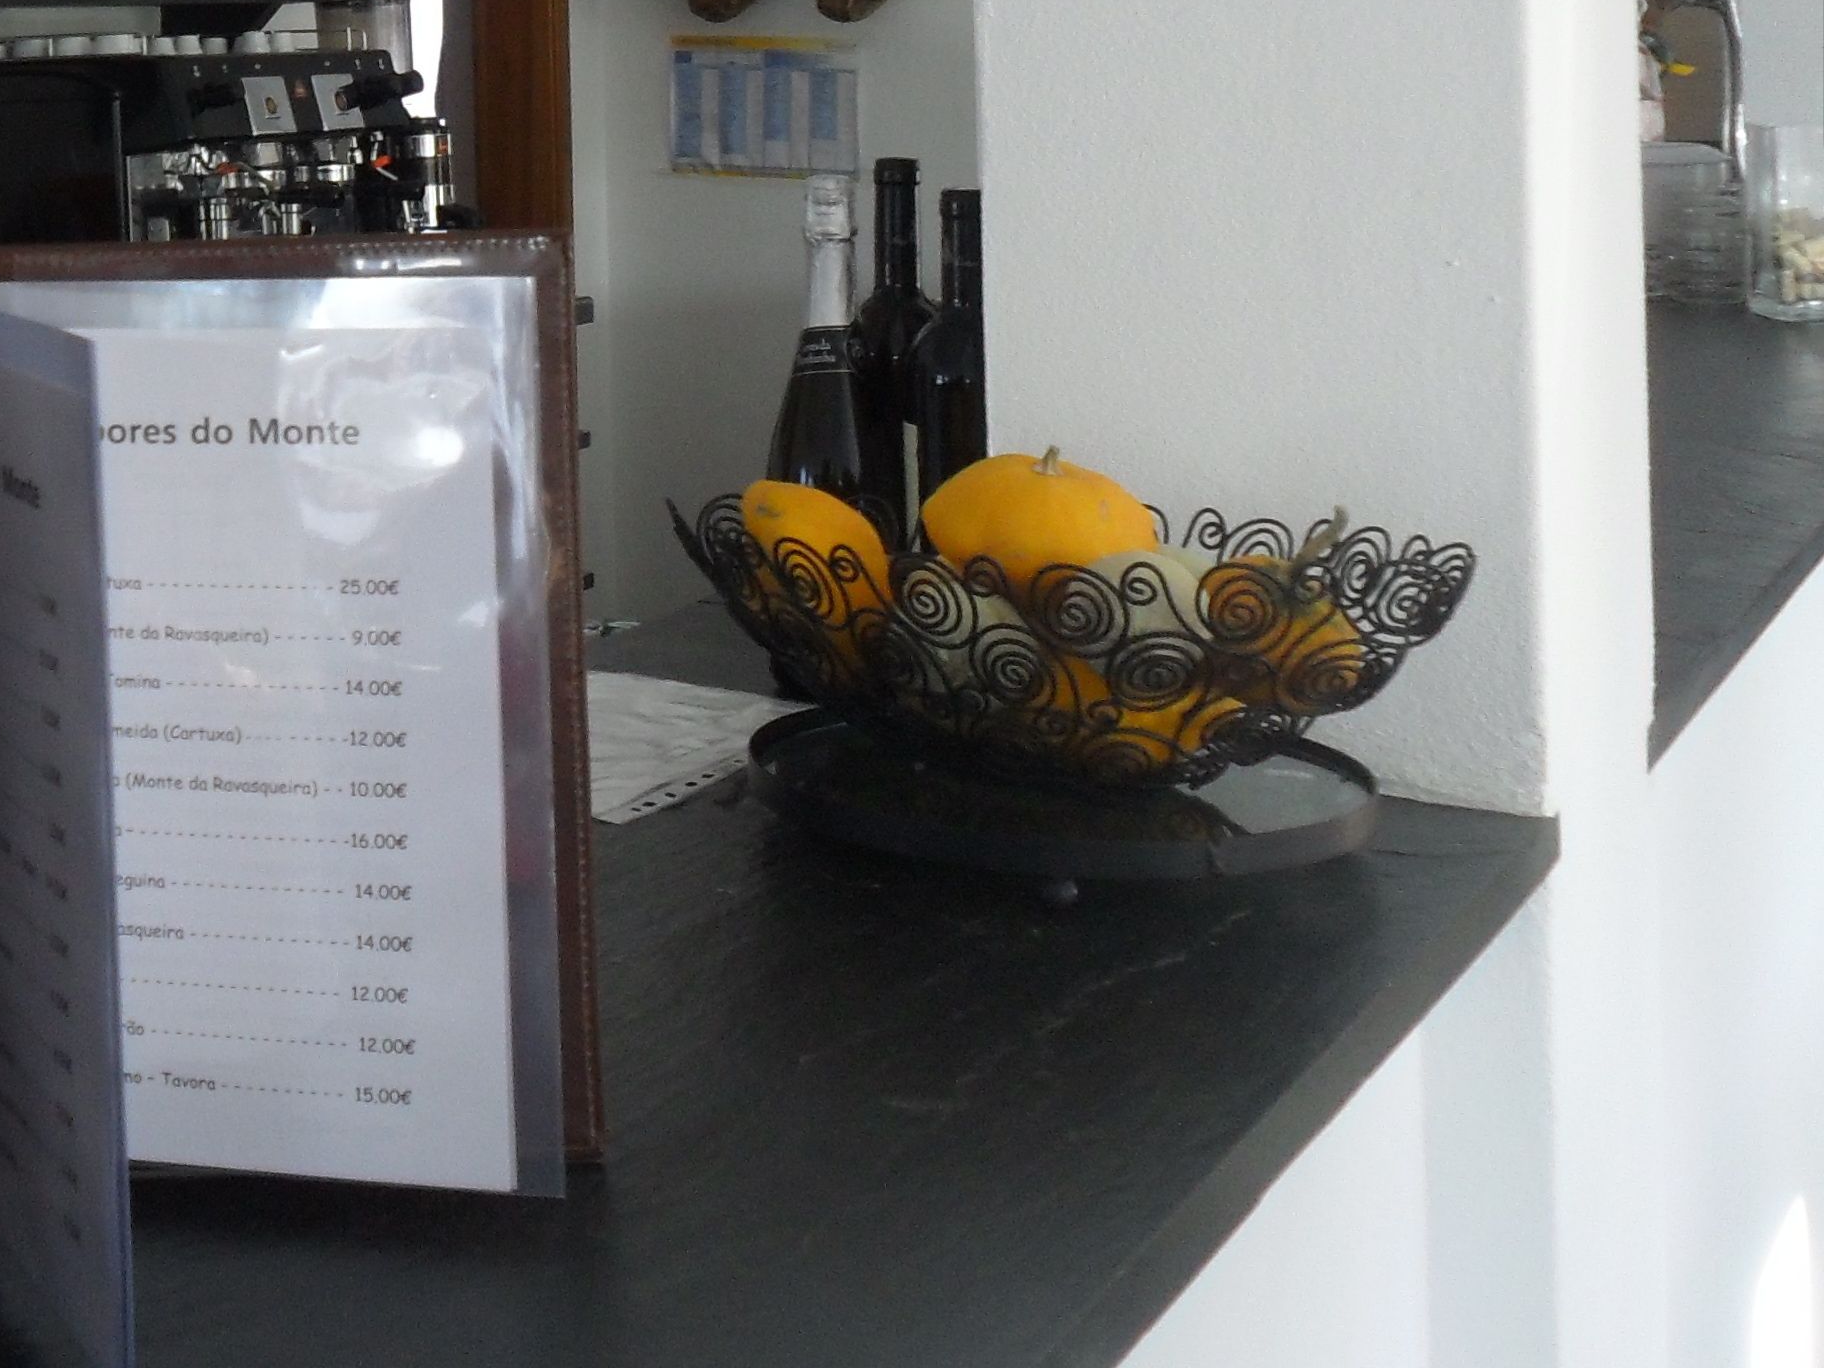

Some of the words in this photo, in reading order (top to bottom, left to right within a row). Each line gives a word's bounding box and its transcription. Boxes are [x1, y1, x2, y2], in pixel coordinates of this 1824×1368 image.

[99, 423, 176, 445] ores
[191, 416, 233, 445] do
[248, 417, 360, 446] Monte
[340, 579, 400, 596] 25.00€
[351, 629, 402, 647] 9.00€
[163, 724, 243, 745] (Cartuxa)
[125, 771, 183, 791] (Monte
[355, 883, 413, 902] 14.00€
[356, 935, 414, 953] 14.00€
[351, 985, 409, 1004] 12.00€
[359, 1036, 417, 1056] 12.00€
[162, 1072, 216, 1091] Tavora
[355, 1086, 413, 1106] 15.00€
